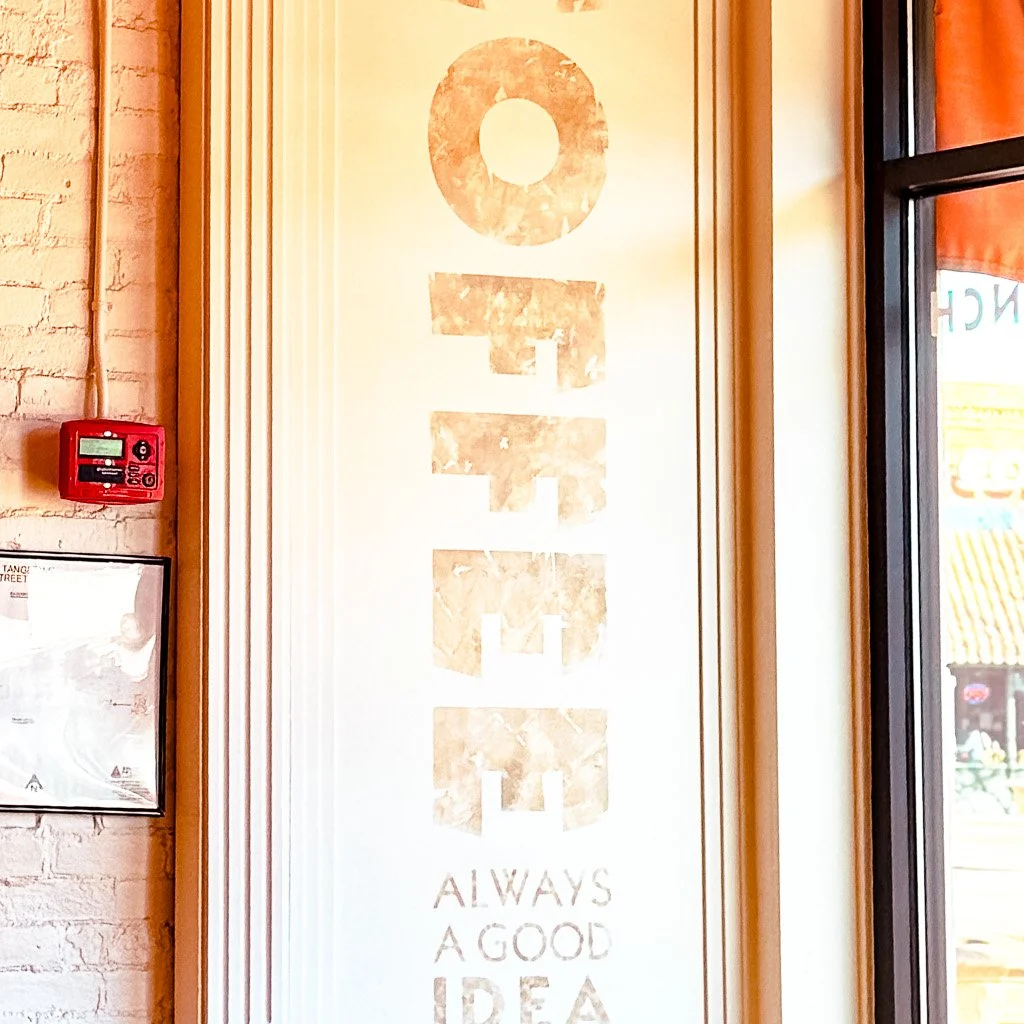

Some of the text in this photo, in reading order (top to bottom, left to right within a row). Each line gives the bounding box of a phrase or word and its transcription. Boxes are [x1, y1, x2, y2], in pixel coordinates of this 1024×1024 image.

[433, 867, 612, 909] ALWAYS
[433, 922, 612, 963] A GOOD
[433, 975, 611, 1024] IDEA
